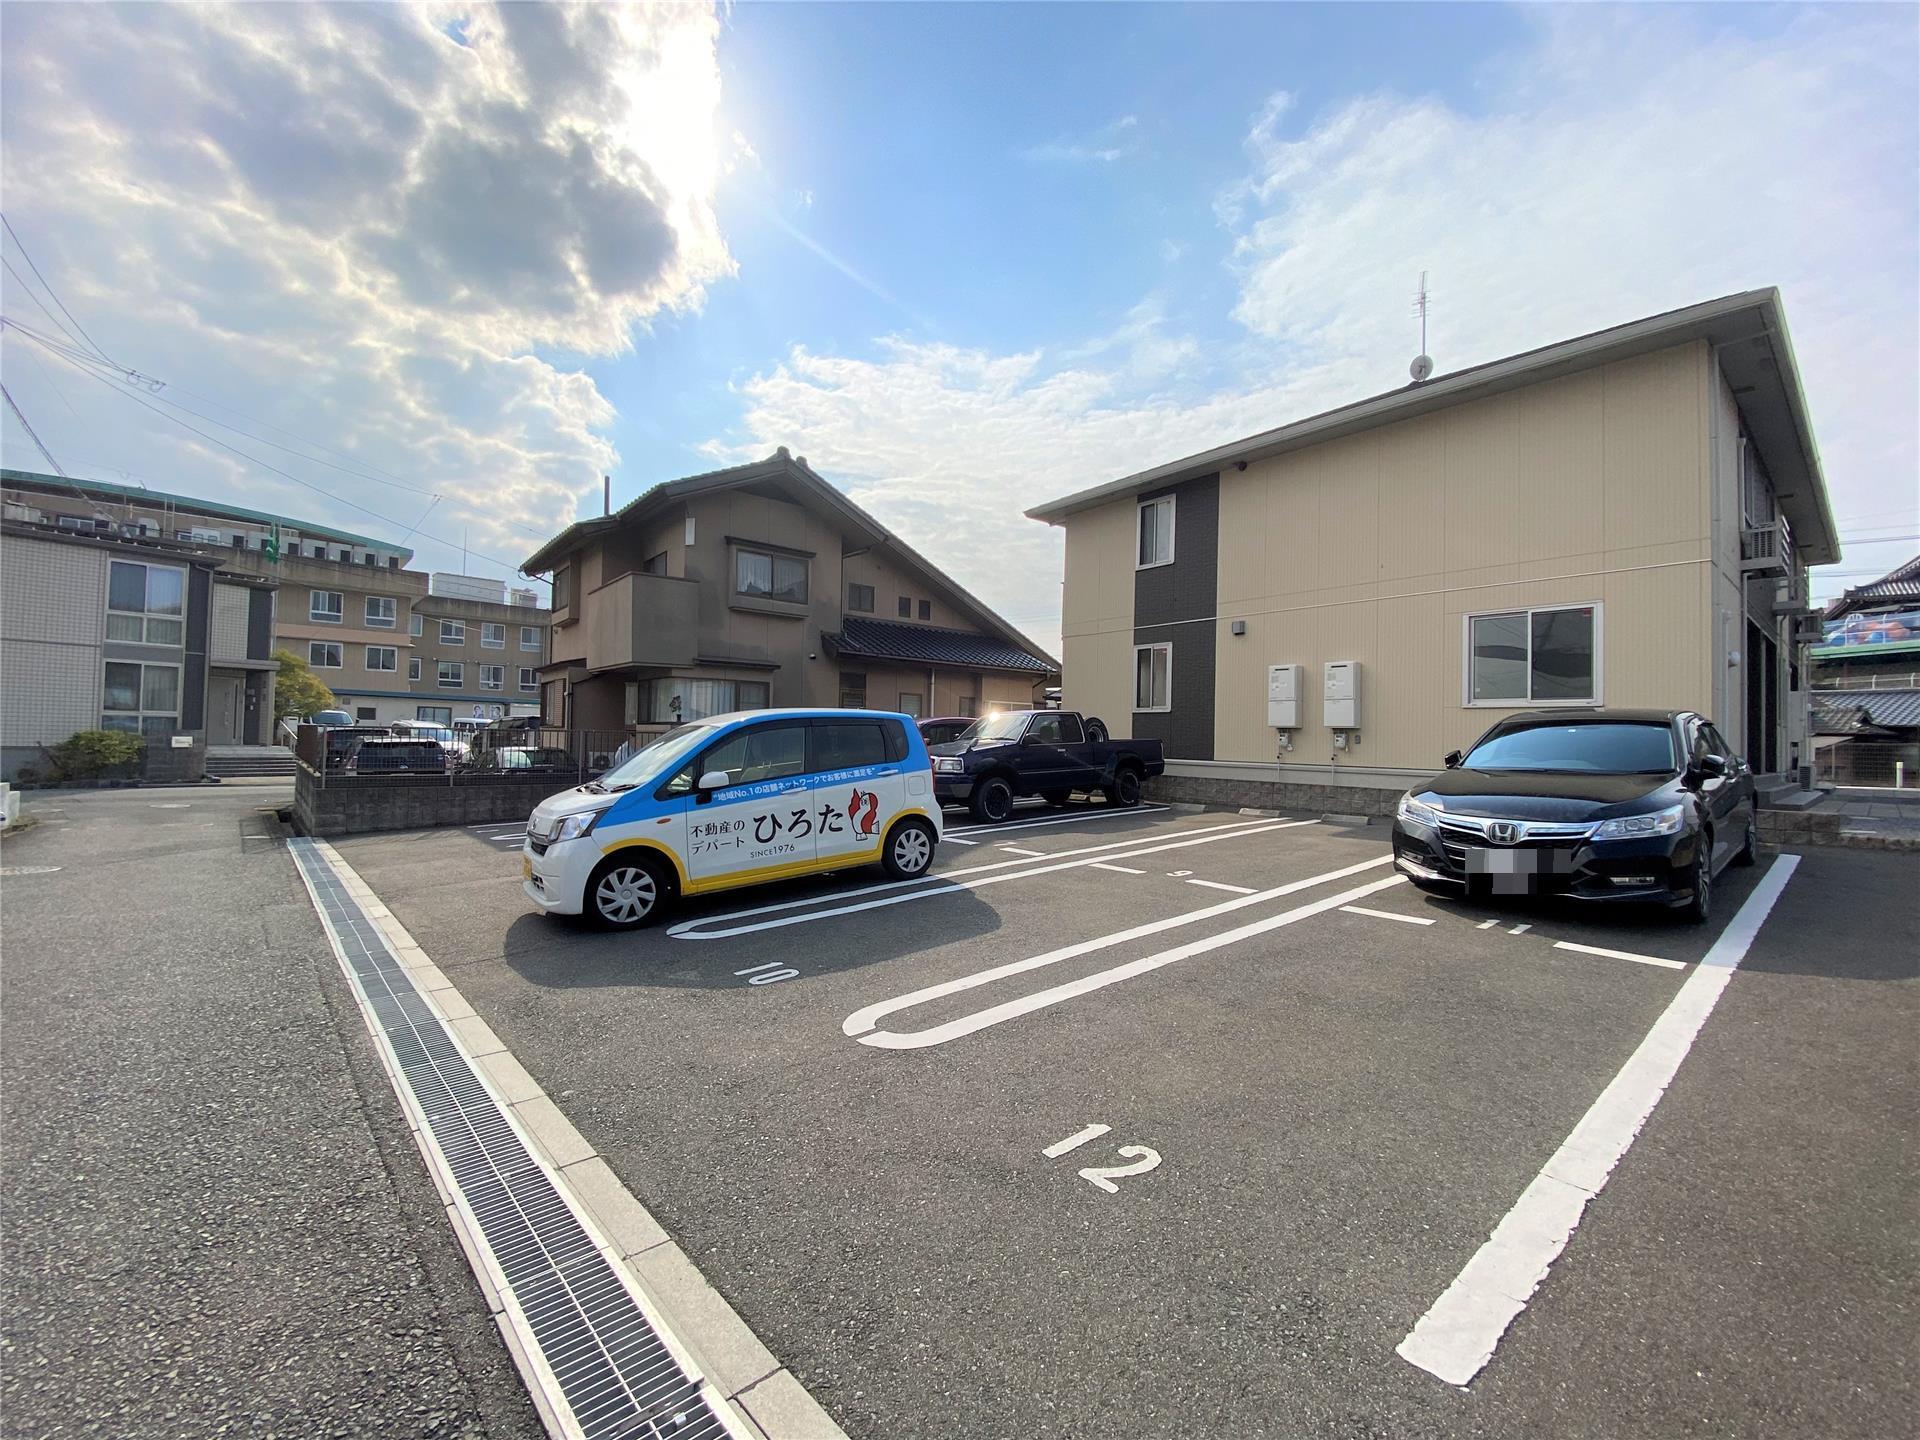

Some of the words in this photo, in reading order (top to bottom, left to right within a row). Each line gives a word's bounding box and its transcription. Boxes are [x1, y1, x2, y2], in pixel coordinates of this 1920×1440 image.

[691, 820, 746, 838] 不動産の
[753, 804, 844, 844] ひろた
[691, 836, 746, 855] デパート
[750, 844, 795, 858] SINCE1976
[733, 961, 800, 985] 10
[1041, 1123, 1162, 1194] 12
